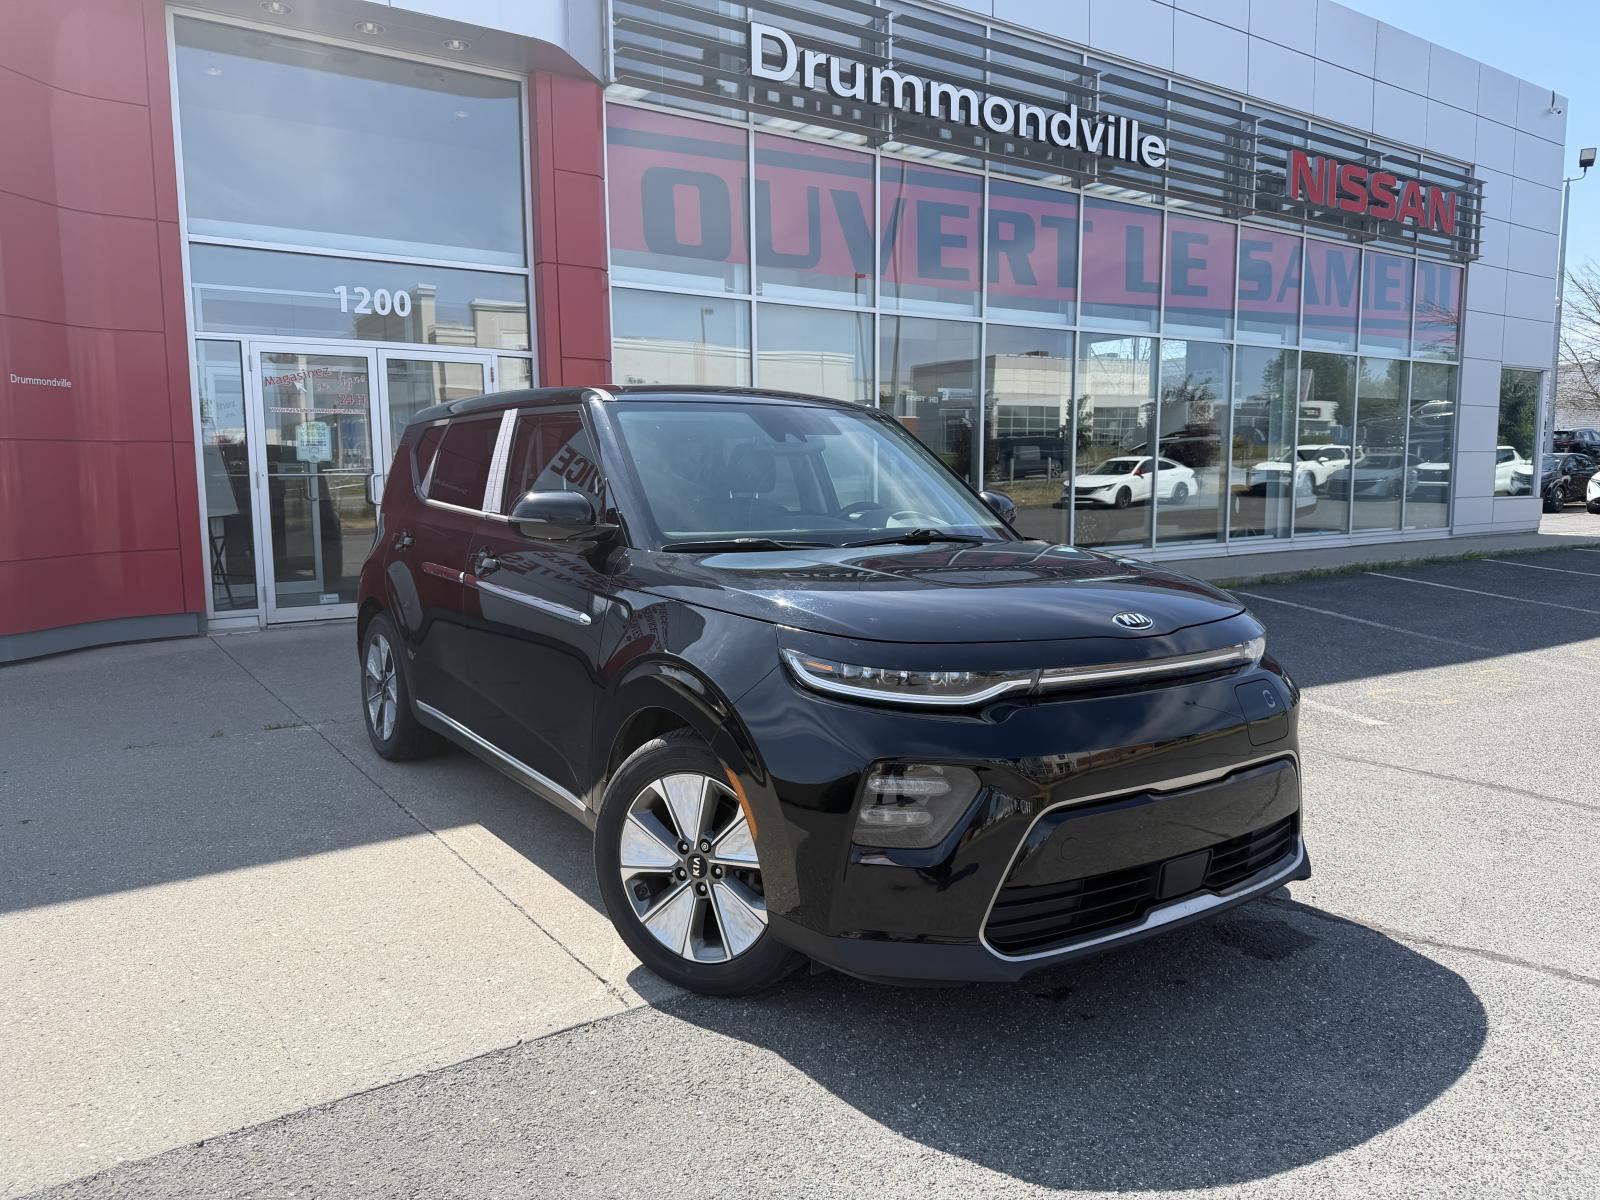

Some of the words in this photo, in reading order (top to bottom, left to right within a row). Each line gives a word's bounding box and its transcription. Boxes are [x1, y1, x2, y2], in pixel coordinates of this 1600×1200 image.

[750, 21, 1168, 169] Drummondville
[1287, 149, 1457, 236] NISSAN
[641, 165, 1093, 290] OUVERT
[1125, 225, 1209, 298] LE
[1237, 237, 1456, 314] SAMEDI
[333, 285, 412, 317] 1200
[9, 373, 72, 388] Drummondville
[264, 367, 331, 388] Magasinez
[692, 856, 701, 877] KIA
